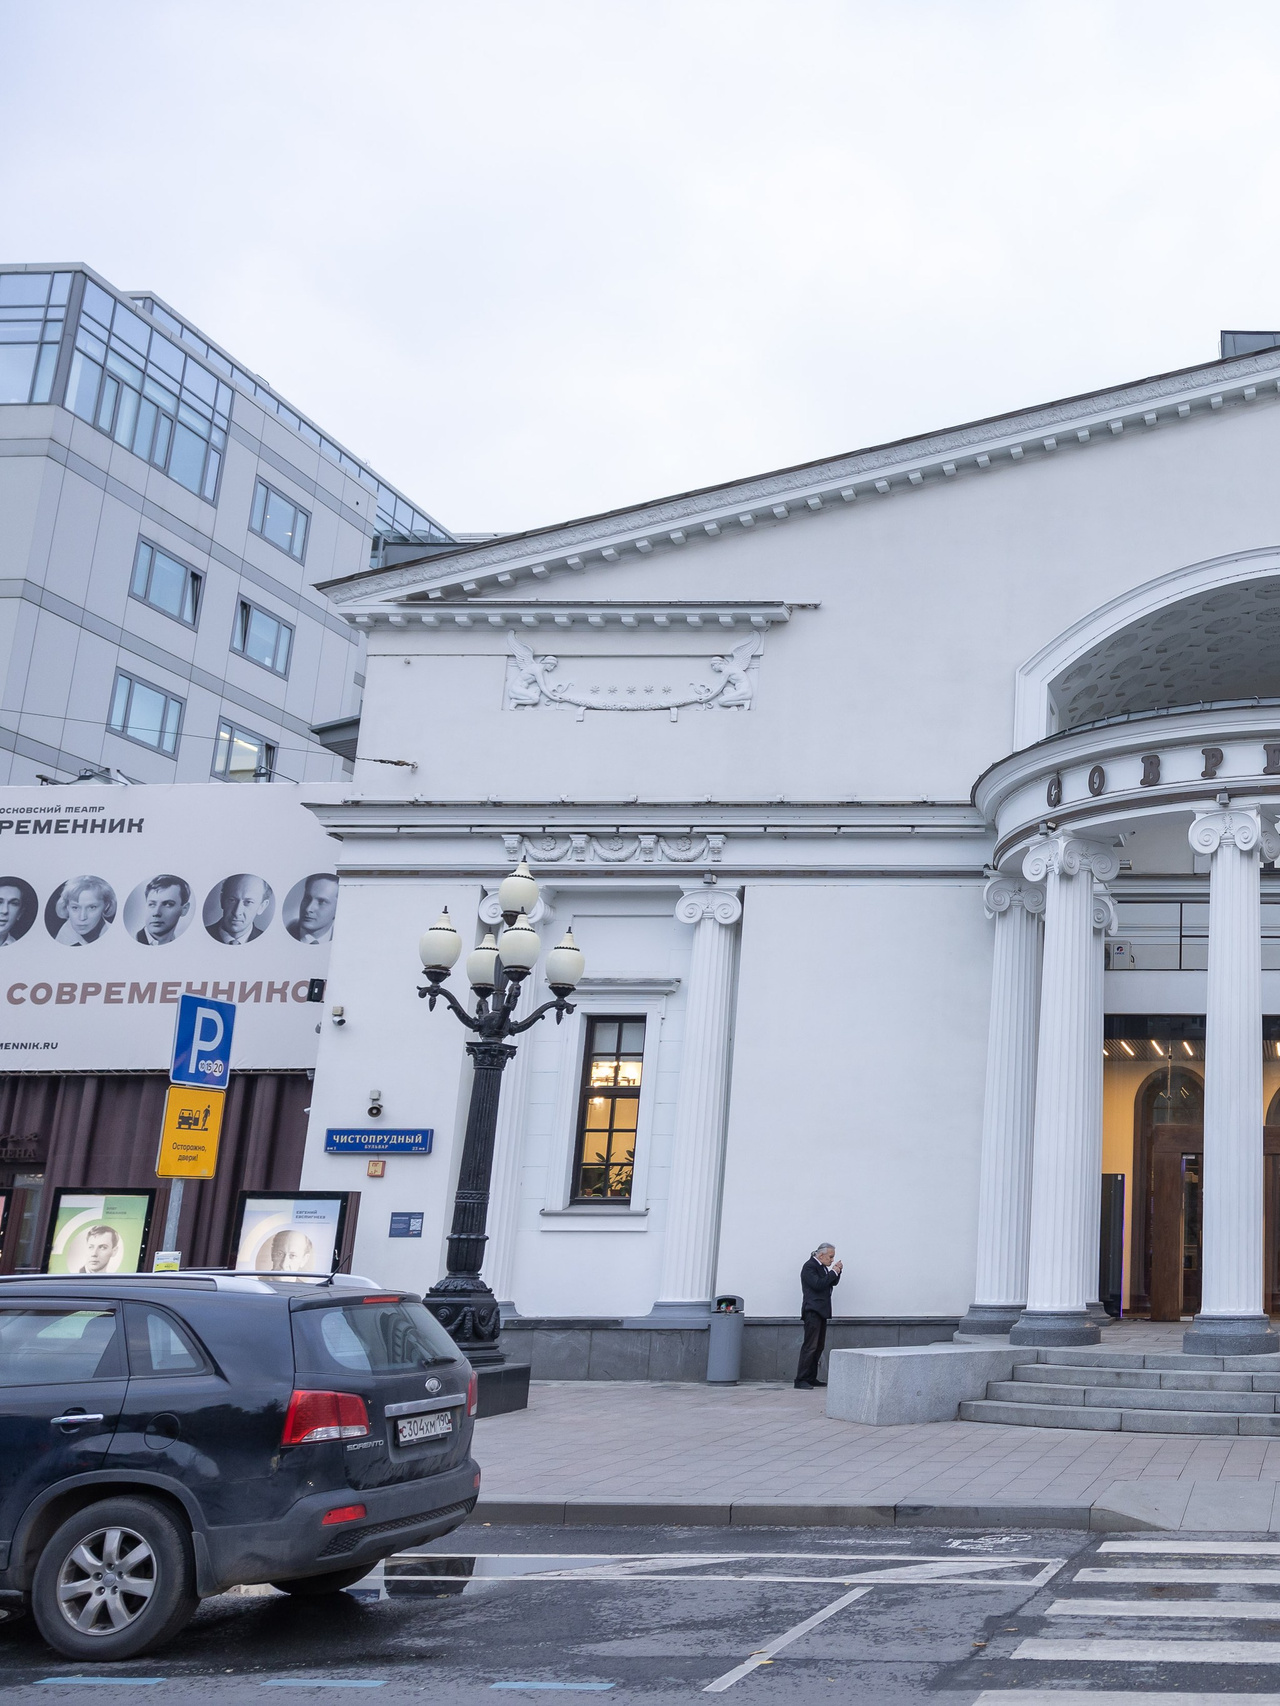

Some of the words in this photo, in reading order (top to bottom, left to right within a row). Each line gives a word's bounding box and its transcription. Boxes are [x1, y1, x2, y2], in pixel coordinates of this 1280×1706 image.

[64, 806, 105, 814] ТЕАТР
[0, 818, 145, 835] РЕМЕННИК
[6, 980, 326, 1005] СОВРЕМЕННИКО
[189, 1006, 224, 1074] P
[213, 1062, 223, 1074] 20
[333, 1134, 423, 1144] ЧИСТОПРУДНЫЙ
[172, 1142, 207, 1152] Осторожно,
[178, 1154, 199, 1162] двери!
[436, 1412, 450, 1427] 190
[346, 1439, 384, 1451] SORENTO
